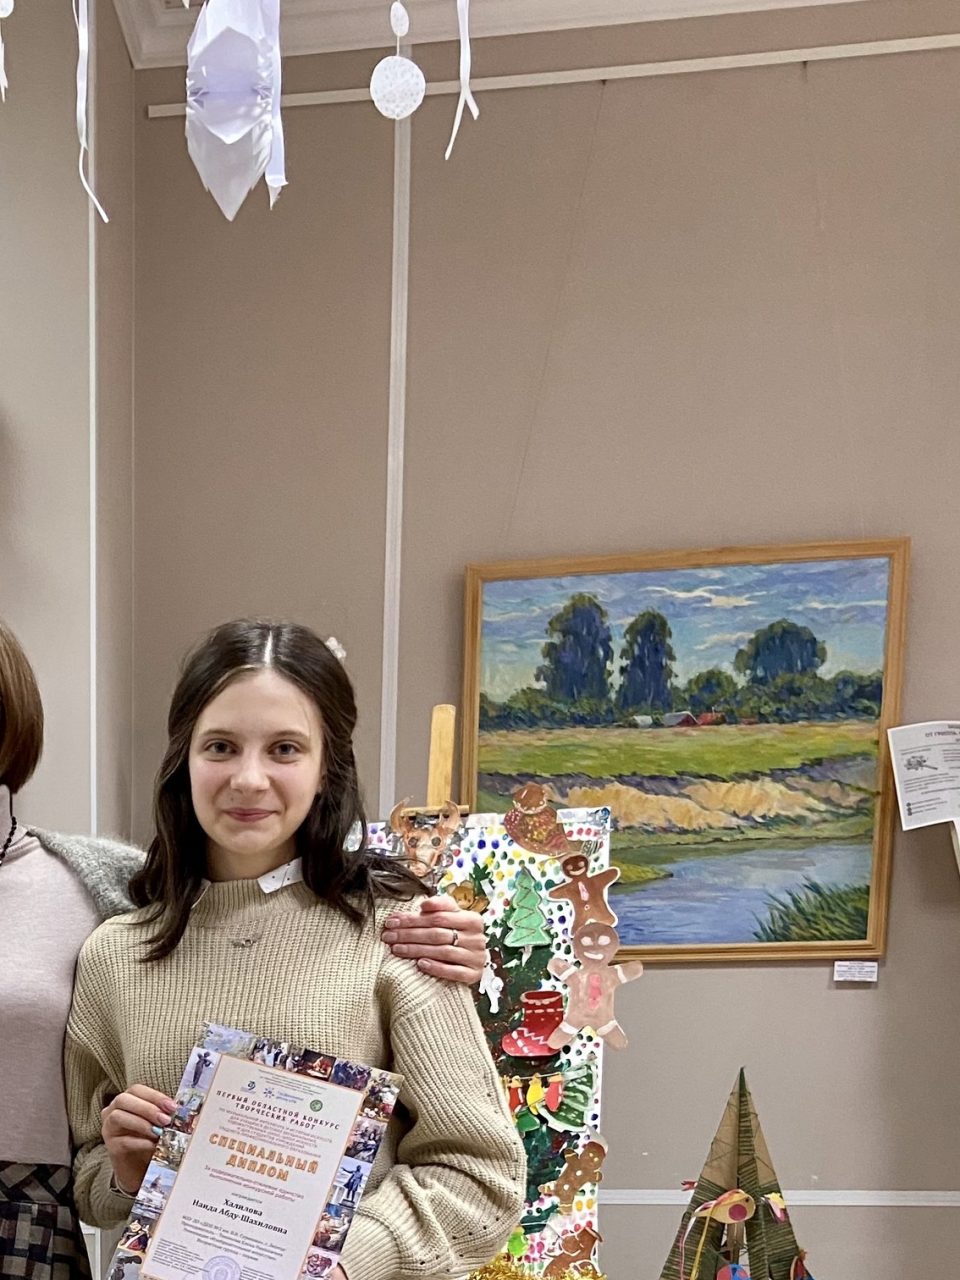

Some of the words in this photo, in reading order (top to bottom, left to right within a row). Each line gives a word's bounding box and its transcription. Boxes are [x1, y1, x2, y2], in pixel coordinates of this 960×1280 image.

[216, 1089, 249, 1103] ПЕРВЫЙ
[251, 1099, 299, 1118] ОБЛАСТНОЙ
[302, 1114, 340, 1130] КОНКУРС
[234, 1102, 286, 1121] ТВОРЧЕСКИХ
[289, 1118, 315, 1130] РАБОТ
[207, 1130, 319, 1175] СПЕЦИАЛЬНЫЙ
[225, 1152, 290, 1183] ДИПЛОМ
[191, 1198, 218, 1213] Наида
[217, 1207, 288, 1236] Абду-Шахиловна
[223, 1198, 263, 1216] Халилова
